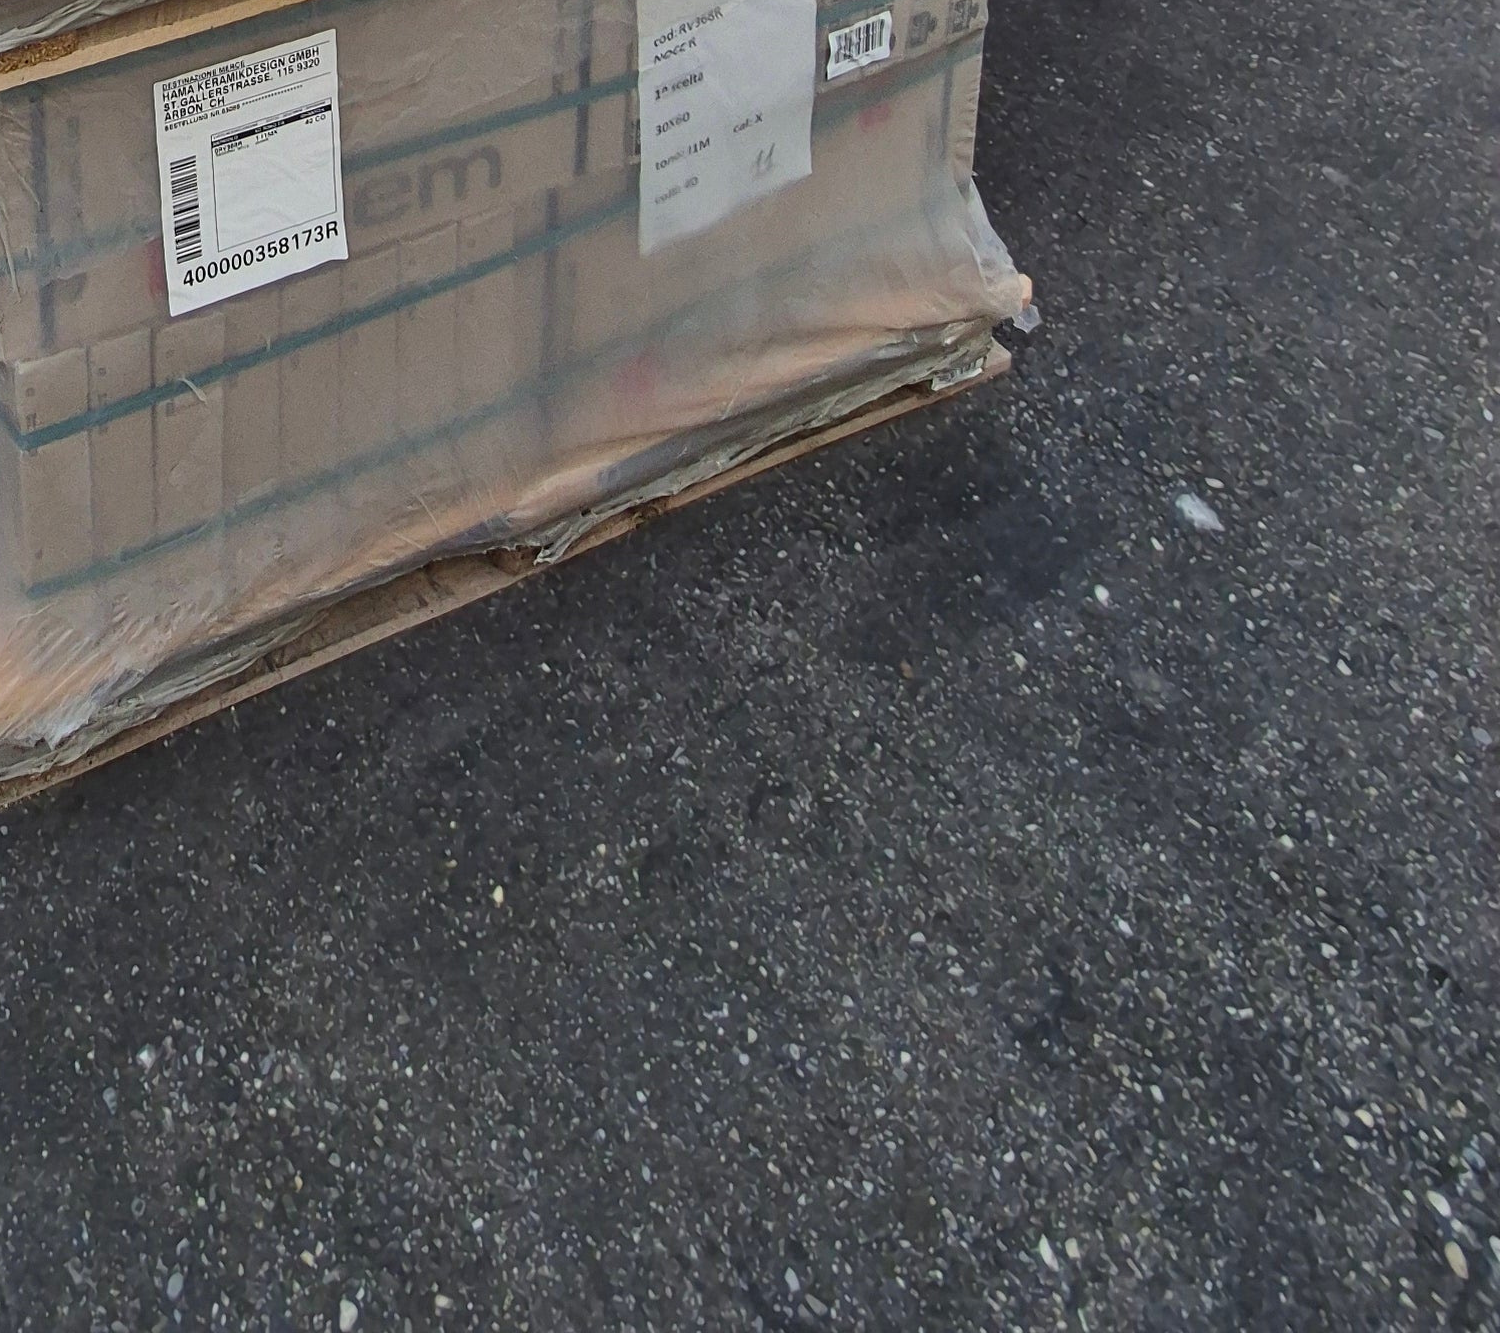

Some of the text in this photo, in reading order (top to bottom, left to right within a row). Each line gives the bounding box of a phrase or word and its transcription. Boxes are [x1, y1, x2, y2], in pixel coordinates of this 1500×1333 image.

[162, 46, 320, 103] HAMA KERAMIKDESIGN GMBH
[218, 60, 246, 75] MERCE
[276, 64, 294, 78] 115
[296, 57, 321, 71] 9320
[164, 103, 203, 122] ARBON
[209, 95, 226, 109] CH
[183, 220, 339, 287] 400000358173R
